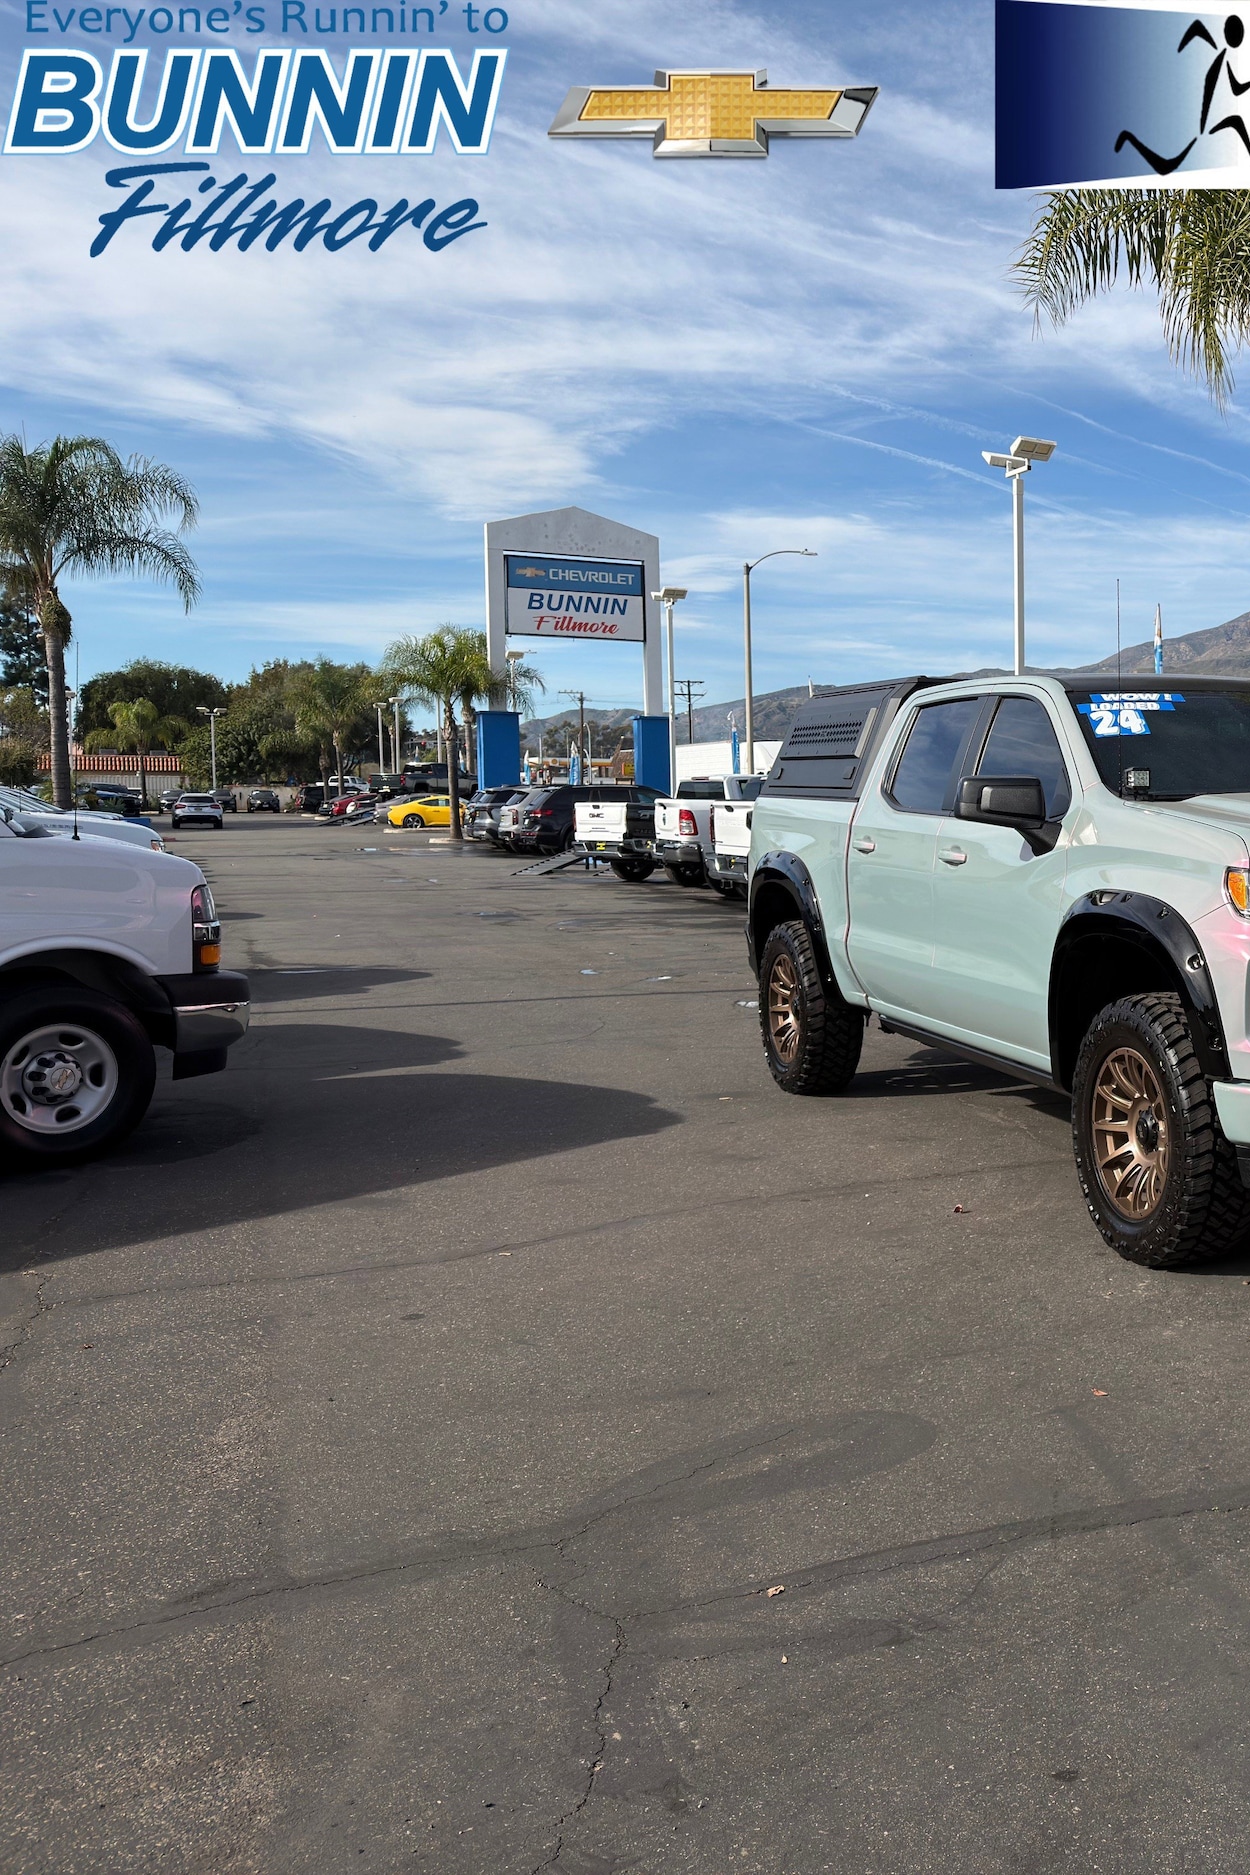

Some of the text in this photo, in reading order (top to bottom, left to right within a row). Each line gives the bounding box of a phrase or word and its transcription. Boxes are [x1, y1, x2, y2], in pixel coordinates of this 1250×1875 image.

[549, 567, 635, 586] CHEVROLET
[527, 592, 628, 616] BUNNIN
[532, 615, 620, 635] Fillmore
[1090, 701, 1160, 712] LOADED
[1089, 709, 1146, 736] 24
